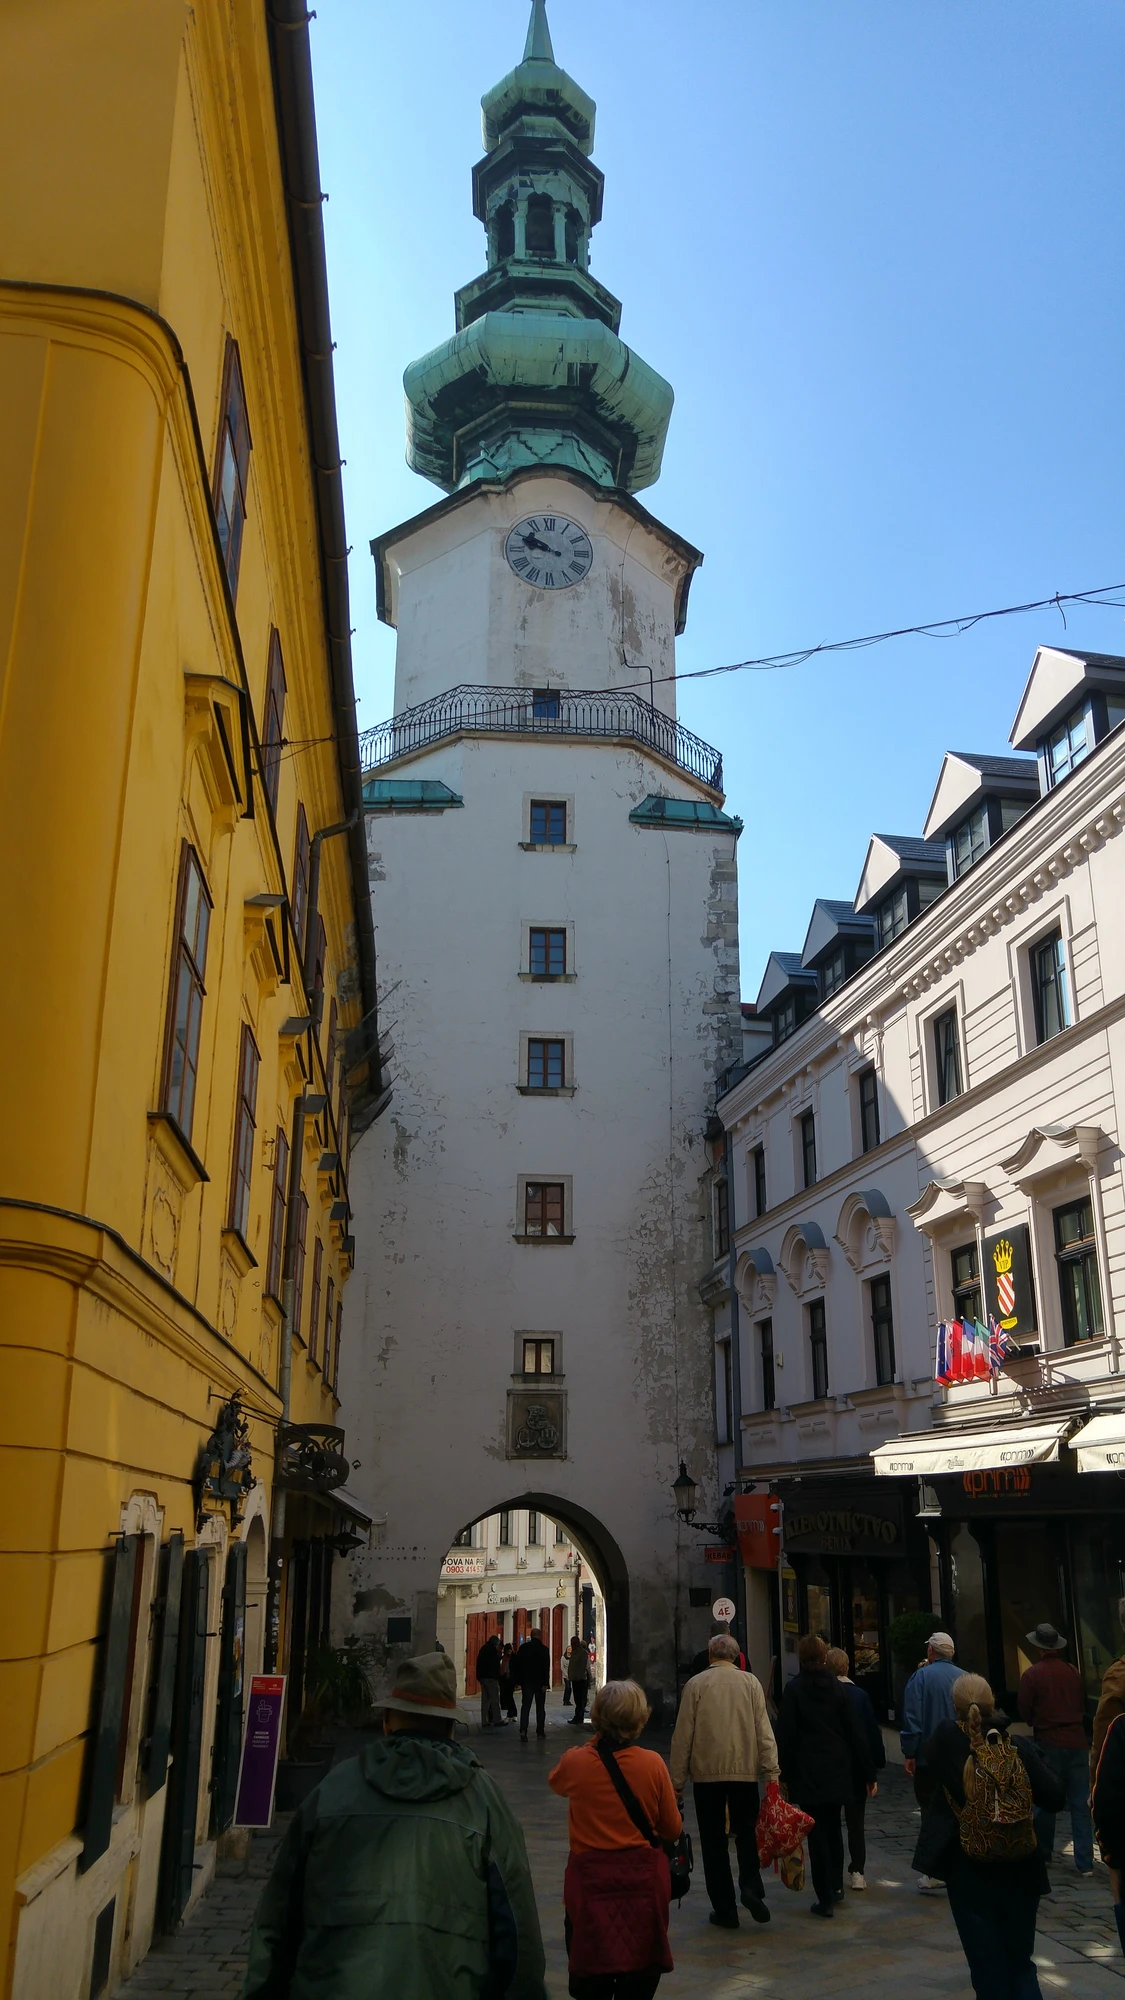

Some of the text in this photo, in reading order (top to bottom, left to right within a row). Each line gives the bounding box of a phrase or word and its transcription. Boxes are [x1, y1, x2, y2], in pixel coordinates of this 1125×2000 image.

[527, 519, 541, 533] XI
[543, 518, 556, 531] XII
[570, 535, 585, 545] II
[574, 550, 589, 558] III
[545, 572, 555, 586] VI
[561, 570, 573, 584] V
[707, 1552, 732, 1560] KEBAB
[446, 1566, 464, 1574] 0903
